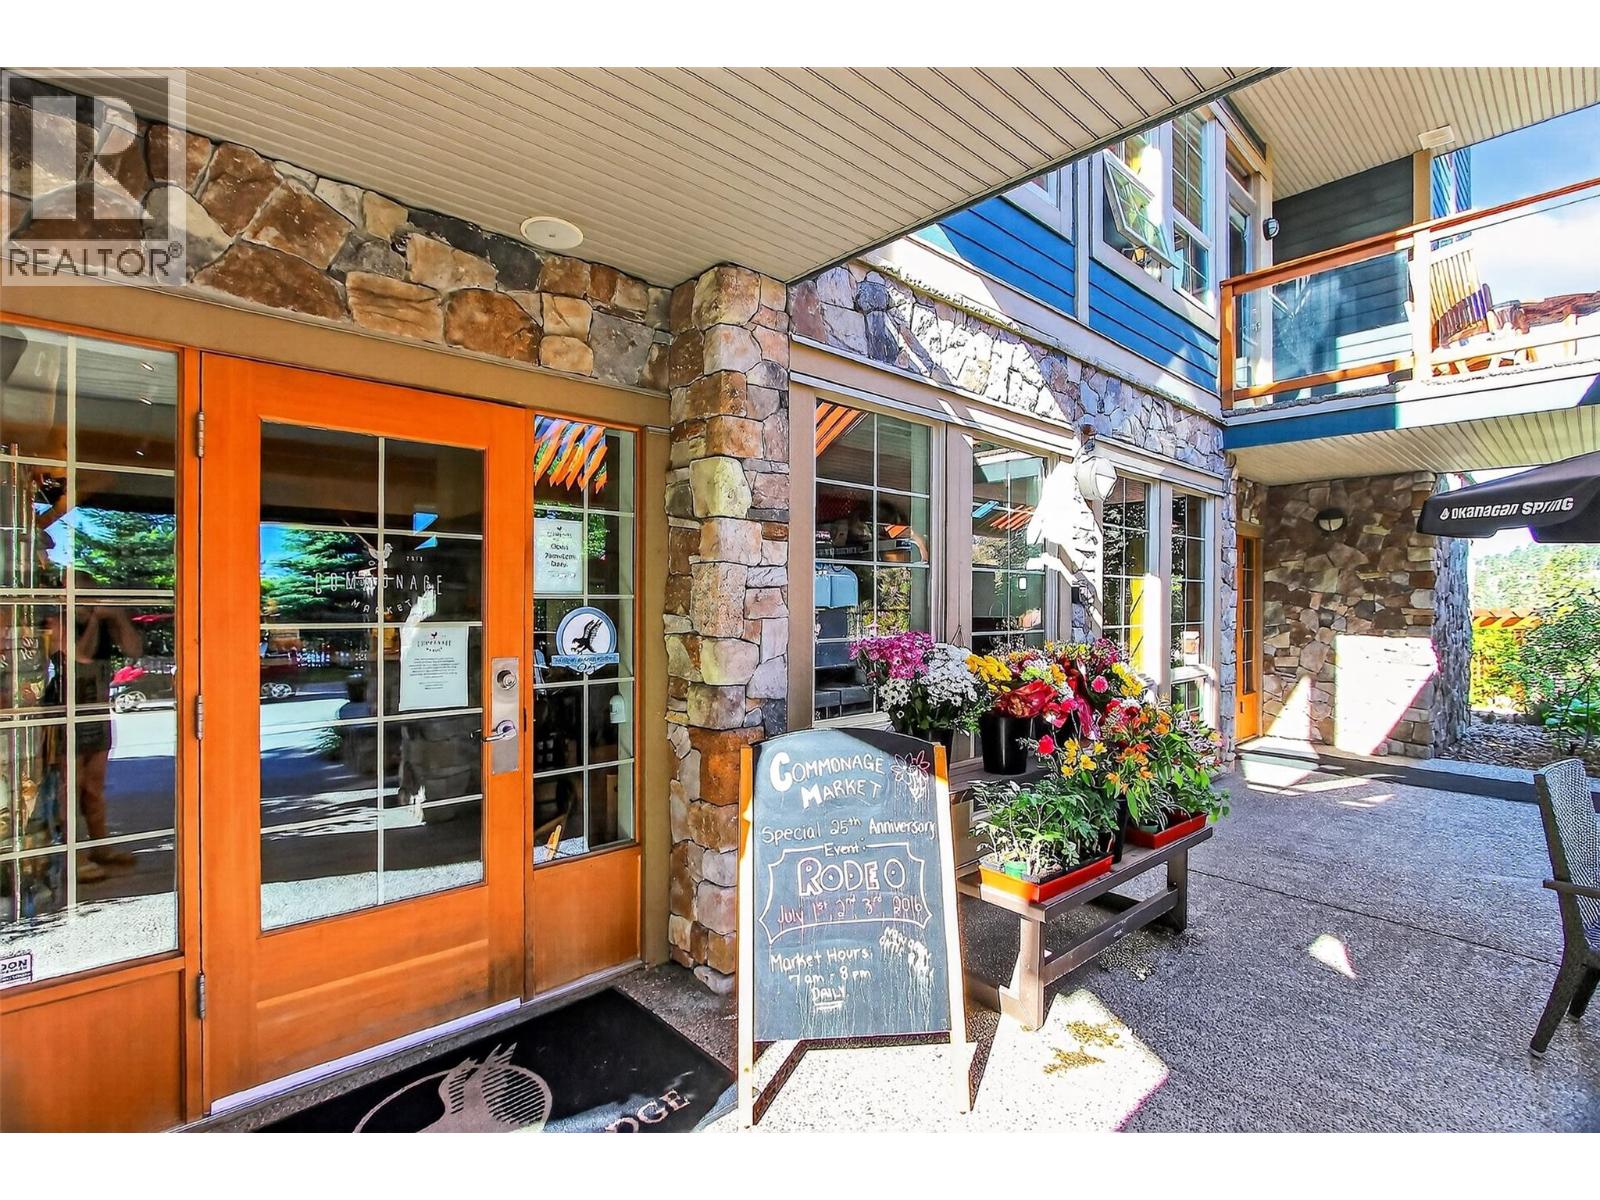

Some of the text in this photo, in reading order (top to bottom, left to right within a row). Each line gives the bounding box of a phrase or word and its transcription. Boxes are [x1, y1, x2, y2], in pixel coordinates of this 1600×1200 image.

[769, 751, 886, 792] COMMONAGE
[800, 779, 882, 809] MARKET
[761, 820, 821, 844] Special
[829, 816, 862, 836] 25th
[797, 856, 906, 897] RODEO
[777, 904, 804, 925] July
[769, 949, 822, 973] Market
